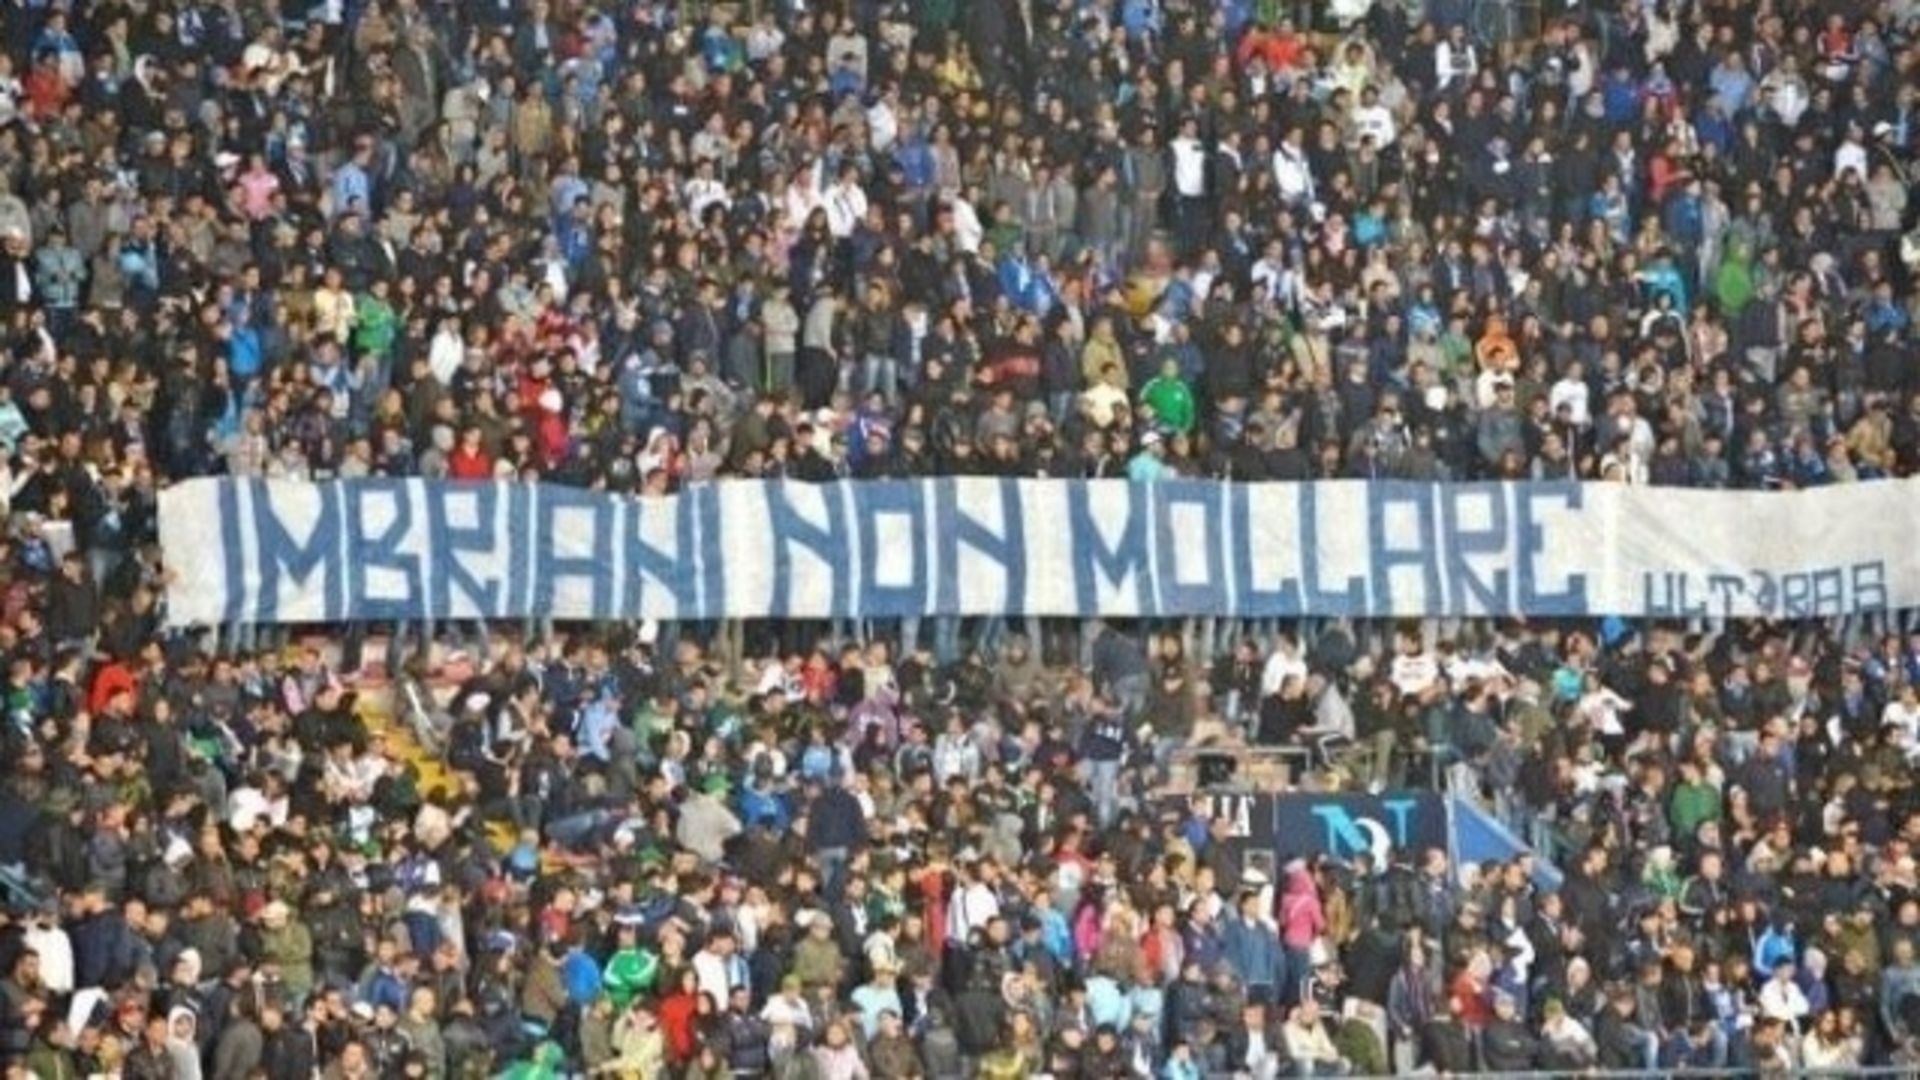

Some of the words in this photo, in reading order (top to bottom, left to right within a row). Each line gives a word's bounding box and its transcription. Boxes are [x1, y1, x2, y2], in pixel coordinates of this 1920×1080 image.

[217, 477, 725, 619] IMBRIANI
[764, 479, 1025, 616] NON
[1066, 479, 1588, 617] MOLLARE
